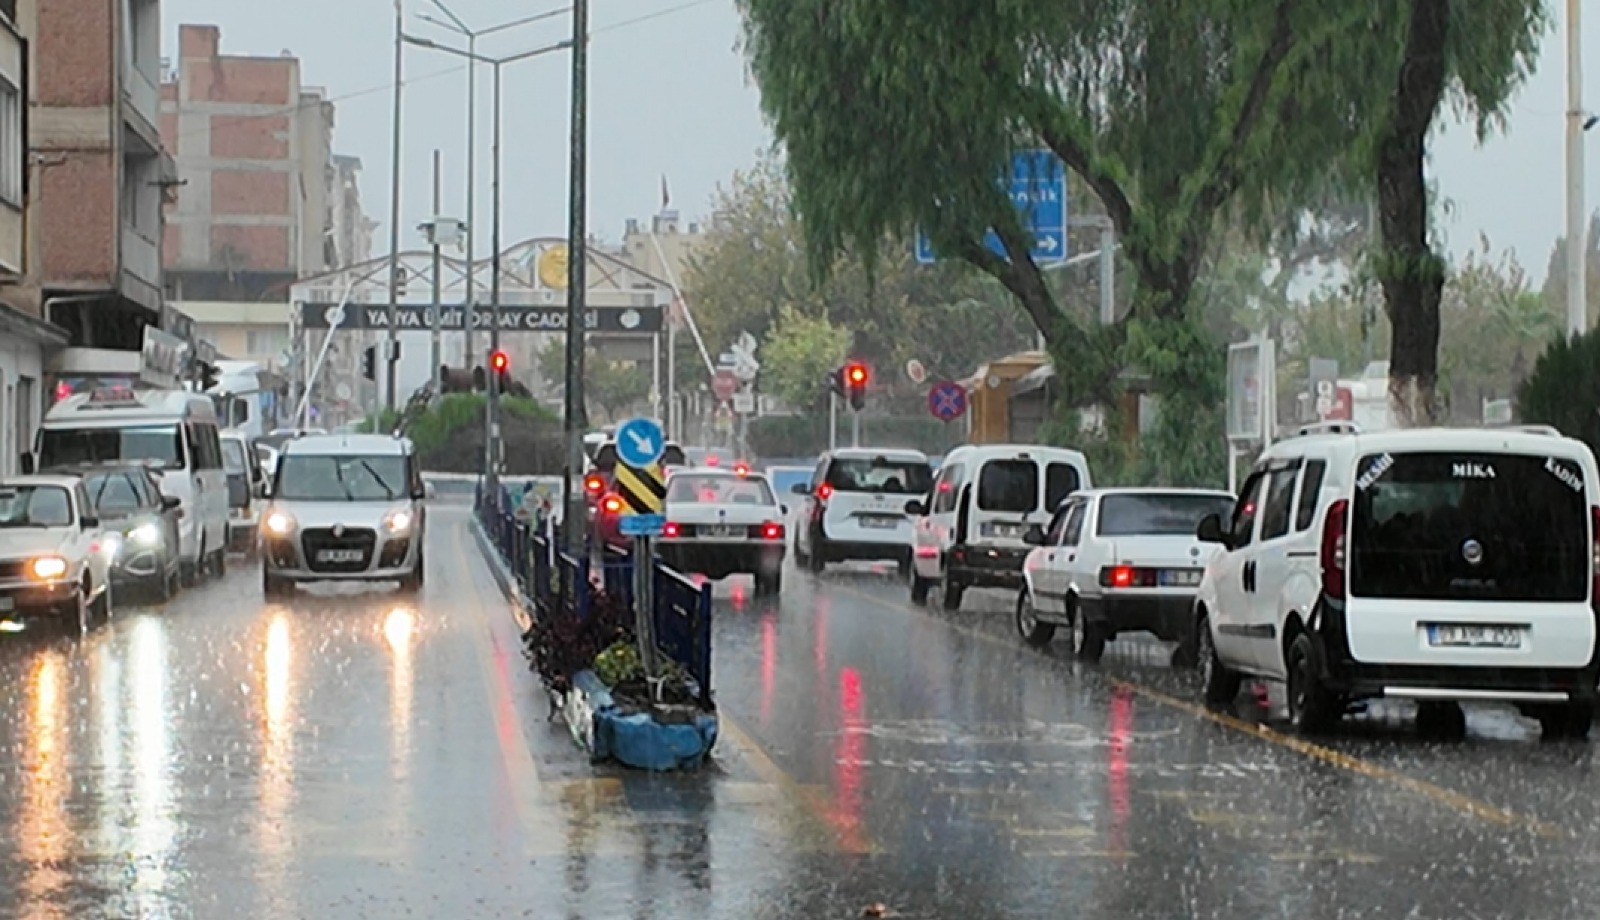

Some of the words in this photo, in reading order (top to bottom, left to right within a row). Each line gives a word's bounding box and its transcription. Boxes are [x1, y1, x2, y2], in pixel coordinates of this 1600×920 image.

[470, 310, 521, 327] ORAY
[525, 308, 598, 328] CADDSİ
[1452, 461, 1496, 478] MİKA
